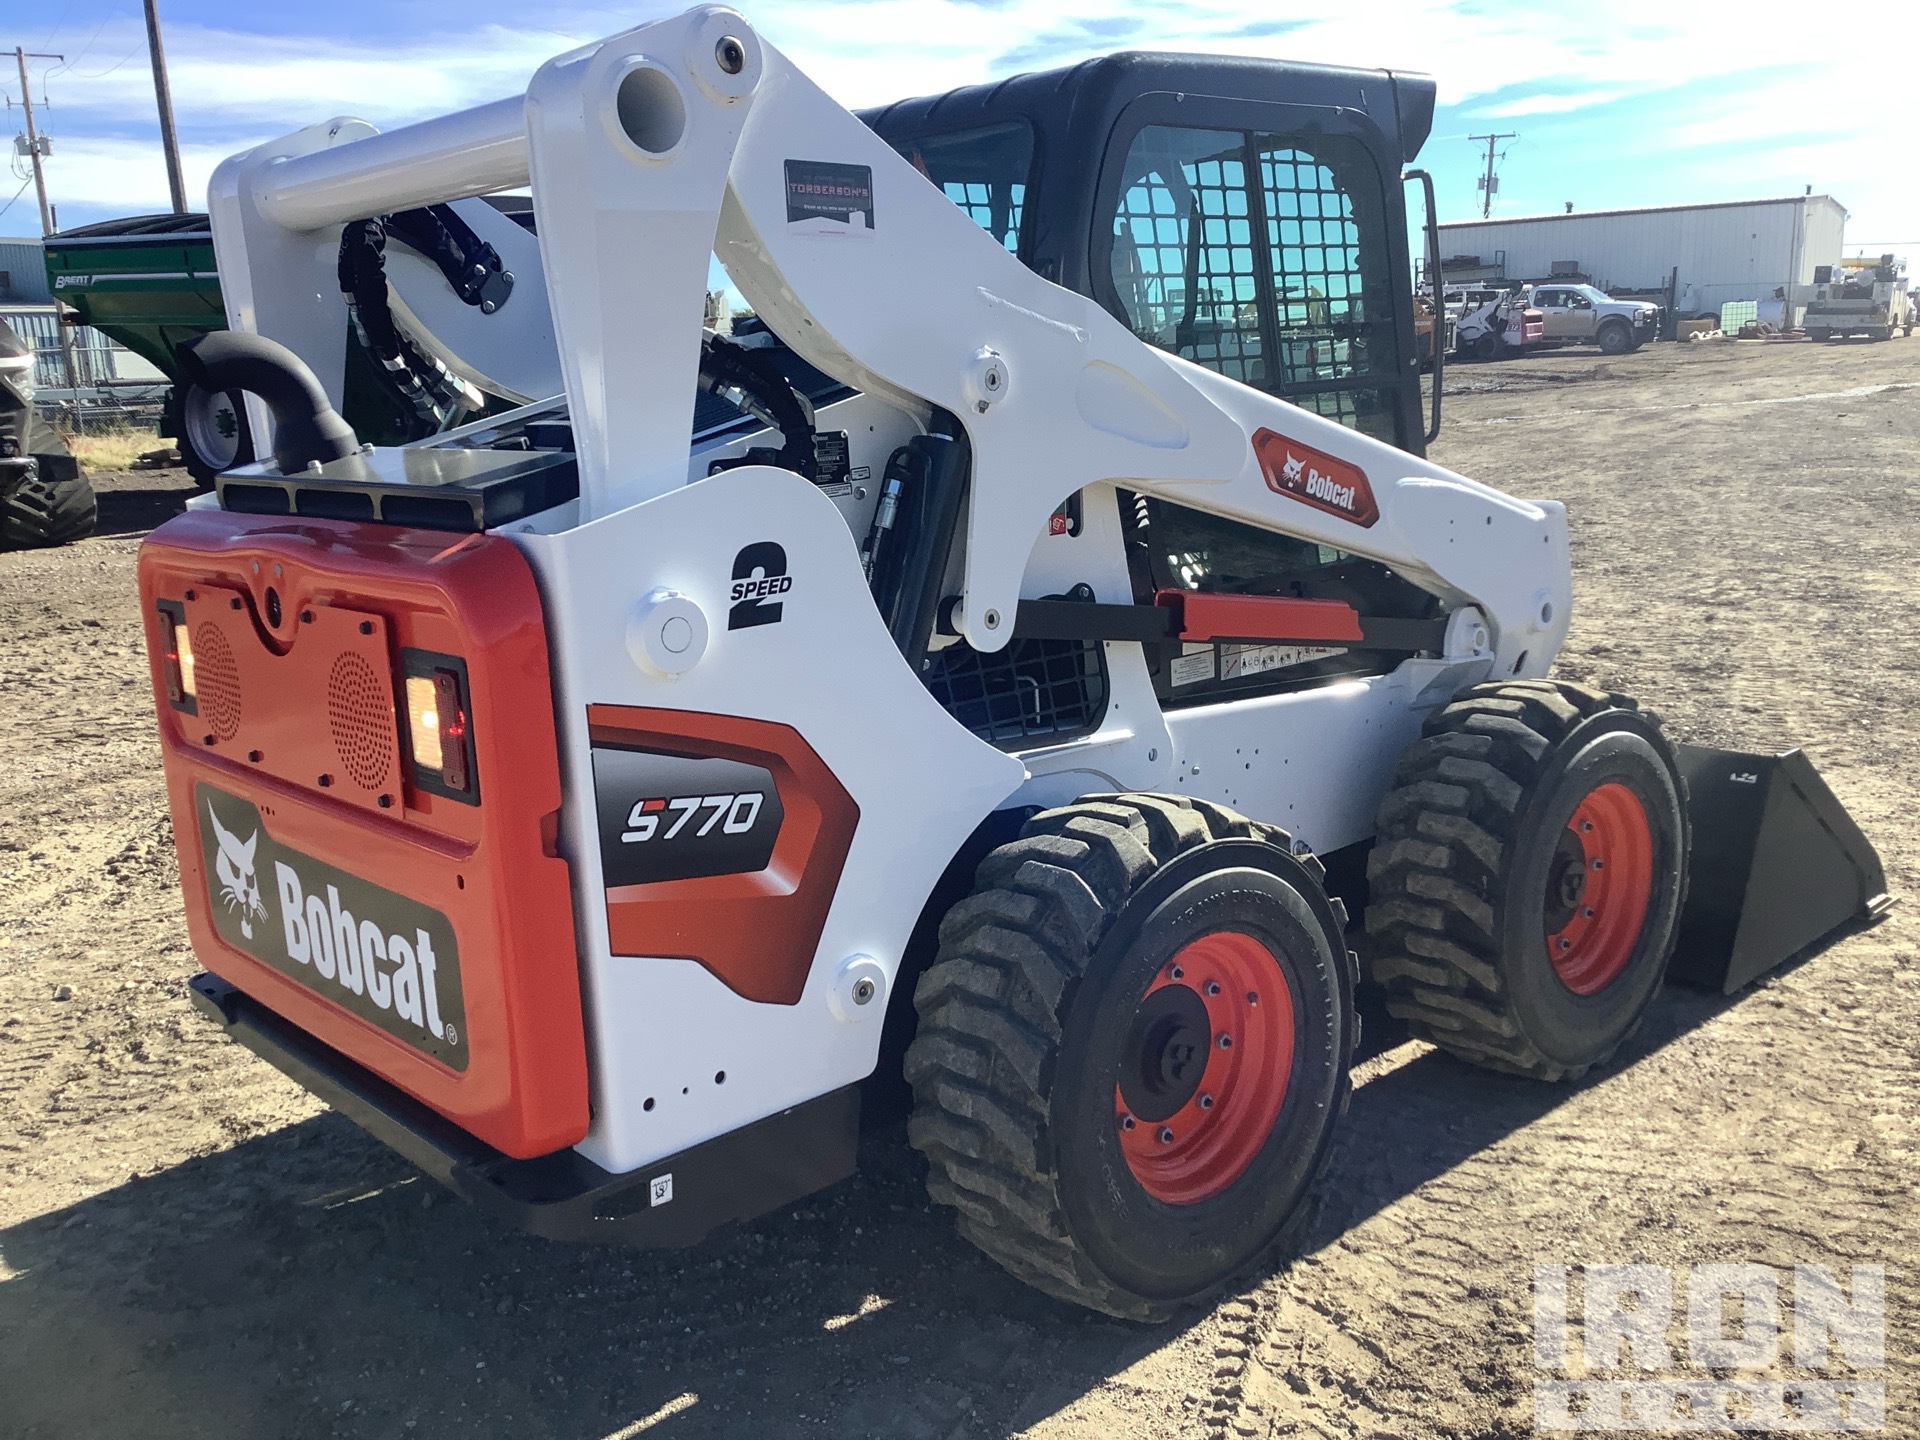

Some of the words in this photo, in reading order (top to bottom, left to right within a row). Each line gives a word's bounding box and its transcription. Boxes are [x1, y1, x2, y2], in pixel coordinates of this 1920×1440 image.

[54, 275, 89, 289] BRENT
[1306, 468, 1355, 510] Bobcat
[728, 541, 787, 631] 2
[730, 576, 793, 601] SPEED
[621, 793, 764, 843] S770
[275, 860, 444, 1040] Bobcat
